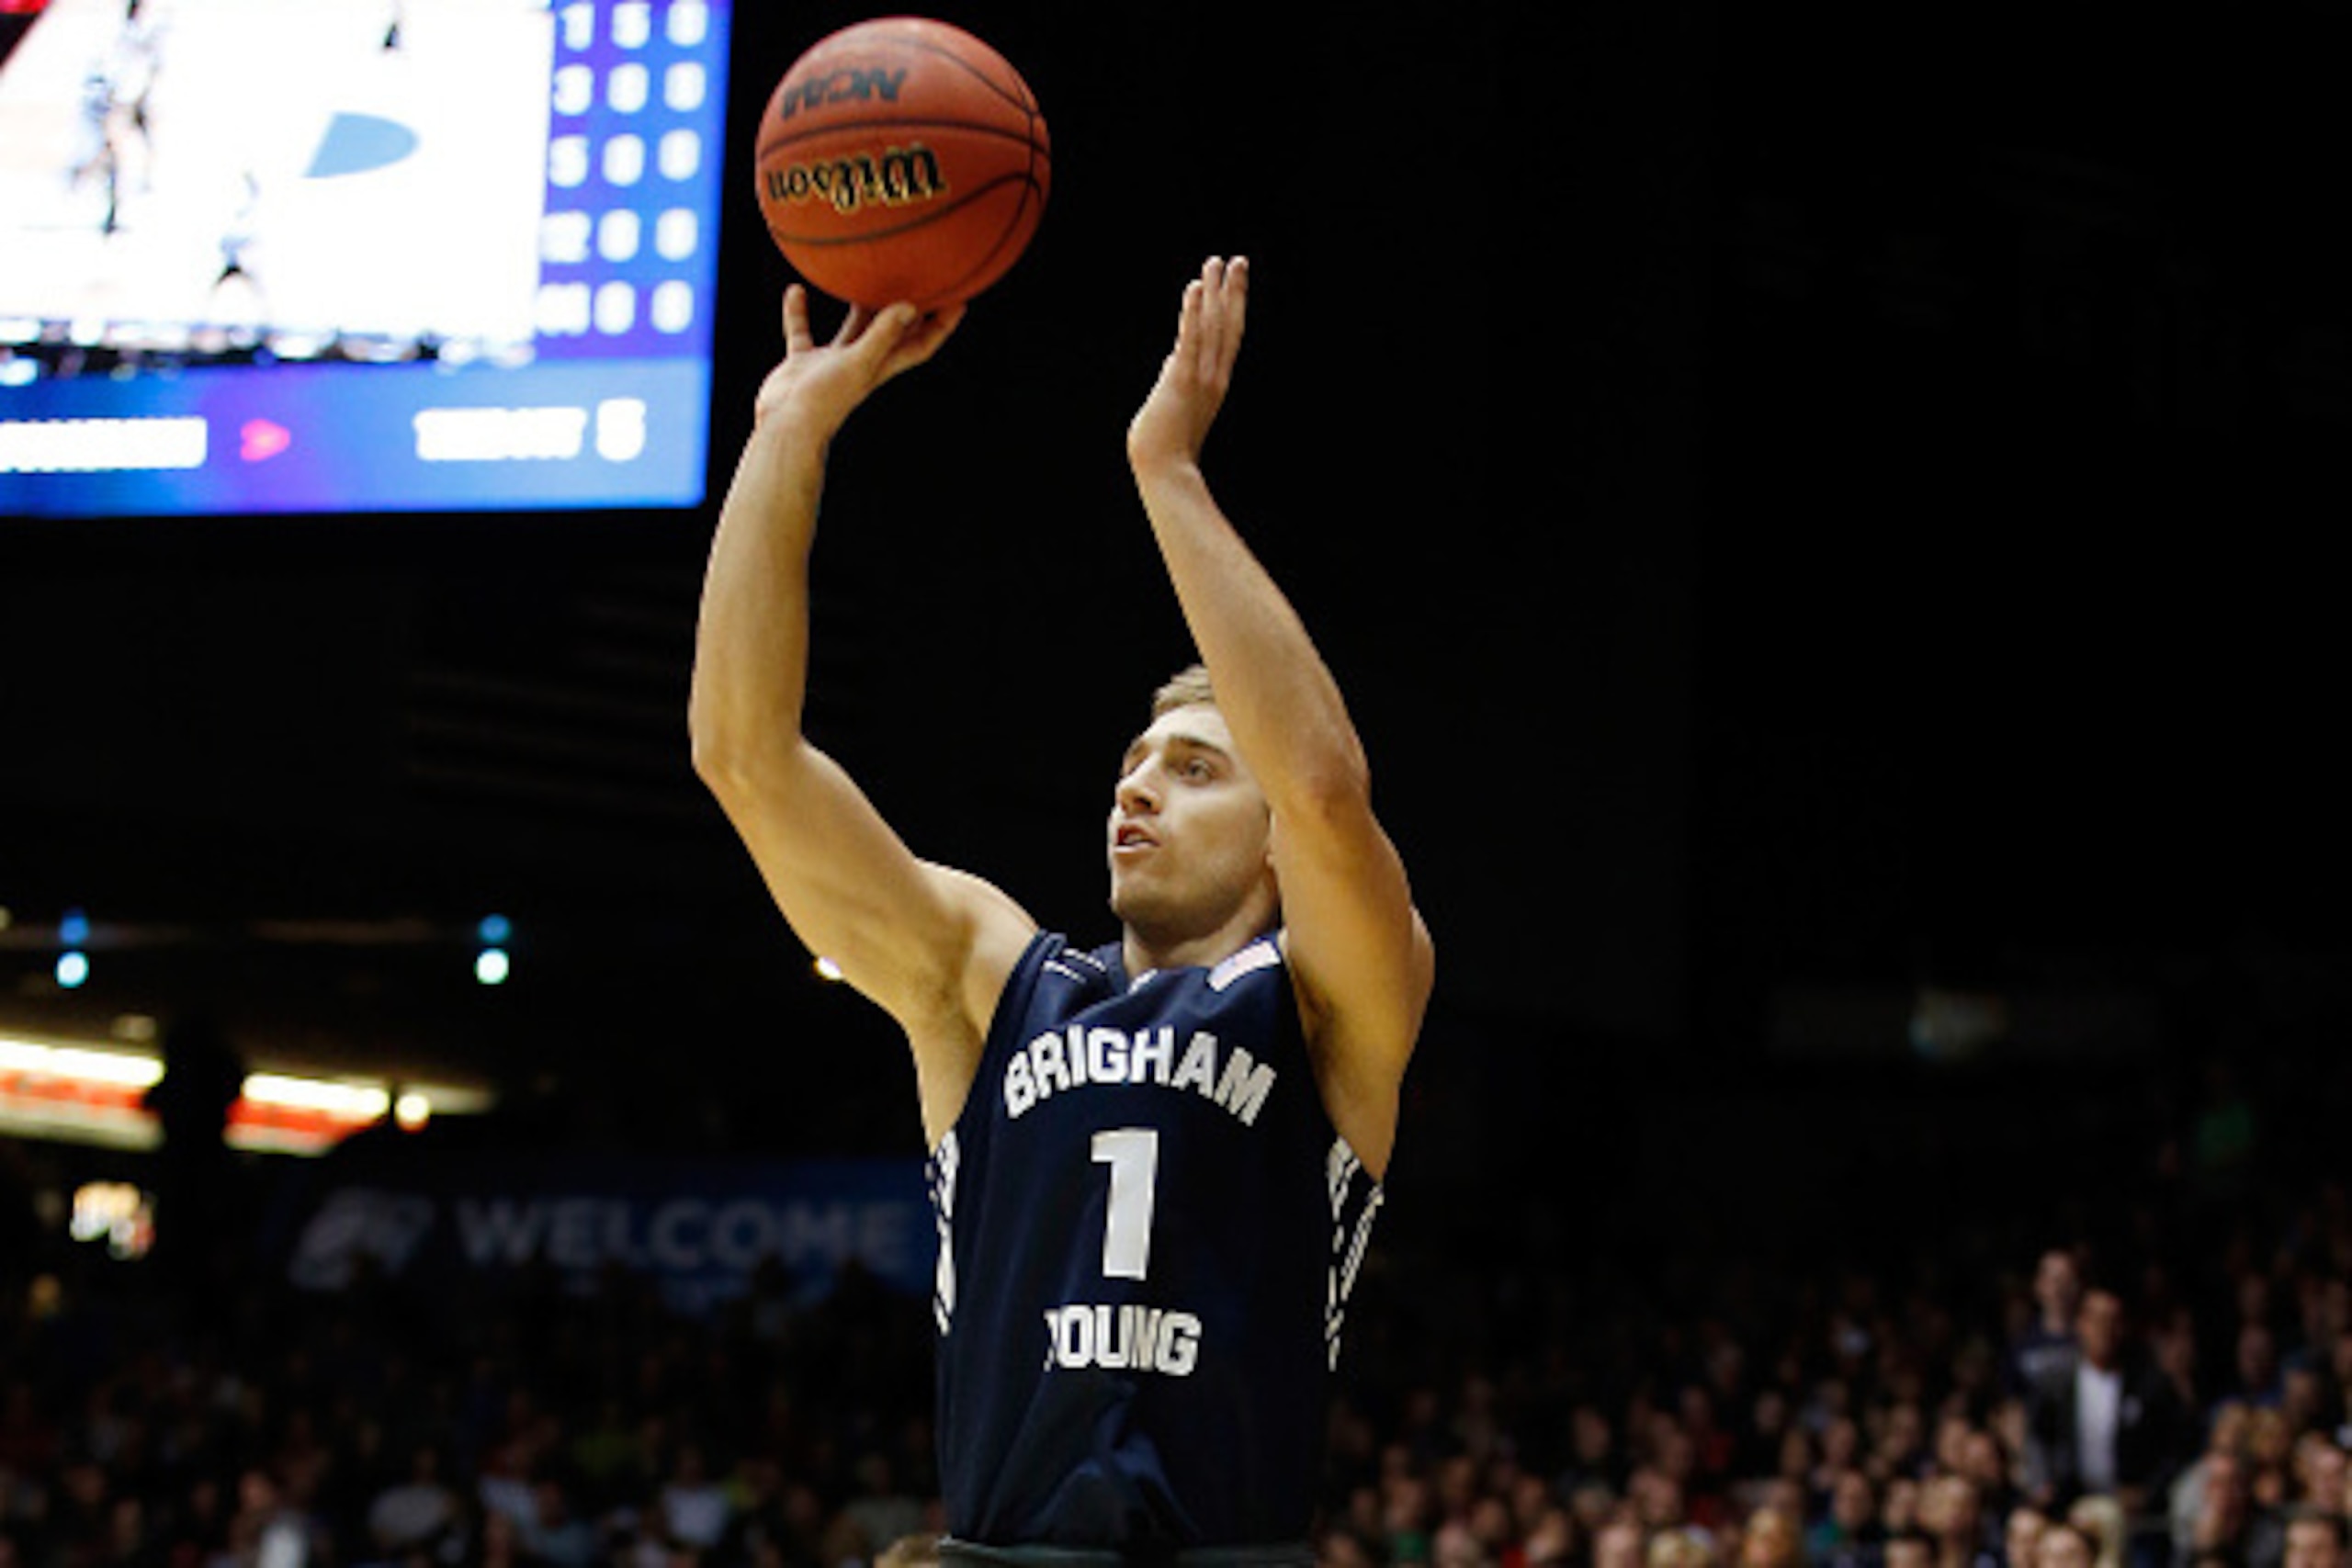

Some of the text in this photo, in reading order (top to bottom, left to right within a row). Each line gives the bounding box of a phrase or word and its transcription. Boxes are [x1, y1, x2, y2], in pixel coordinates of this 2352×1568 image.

[783, 65, 908, 121] NCAA
[766, 142, 948, 215] Wilson
[1003, 1023, 1277, 1127] BRIGHAM
[458, 1194, 910, 1276] WELCOME
[1091, 1125, 1159, 1281] 1
